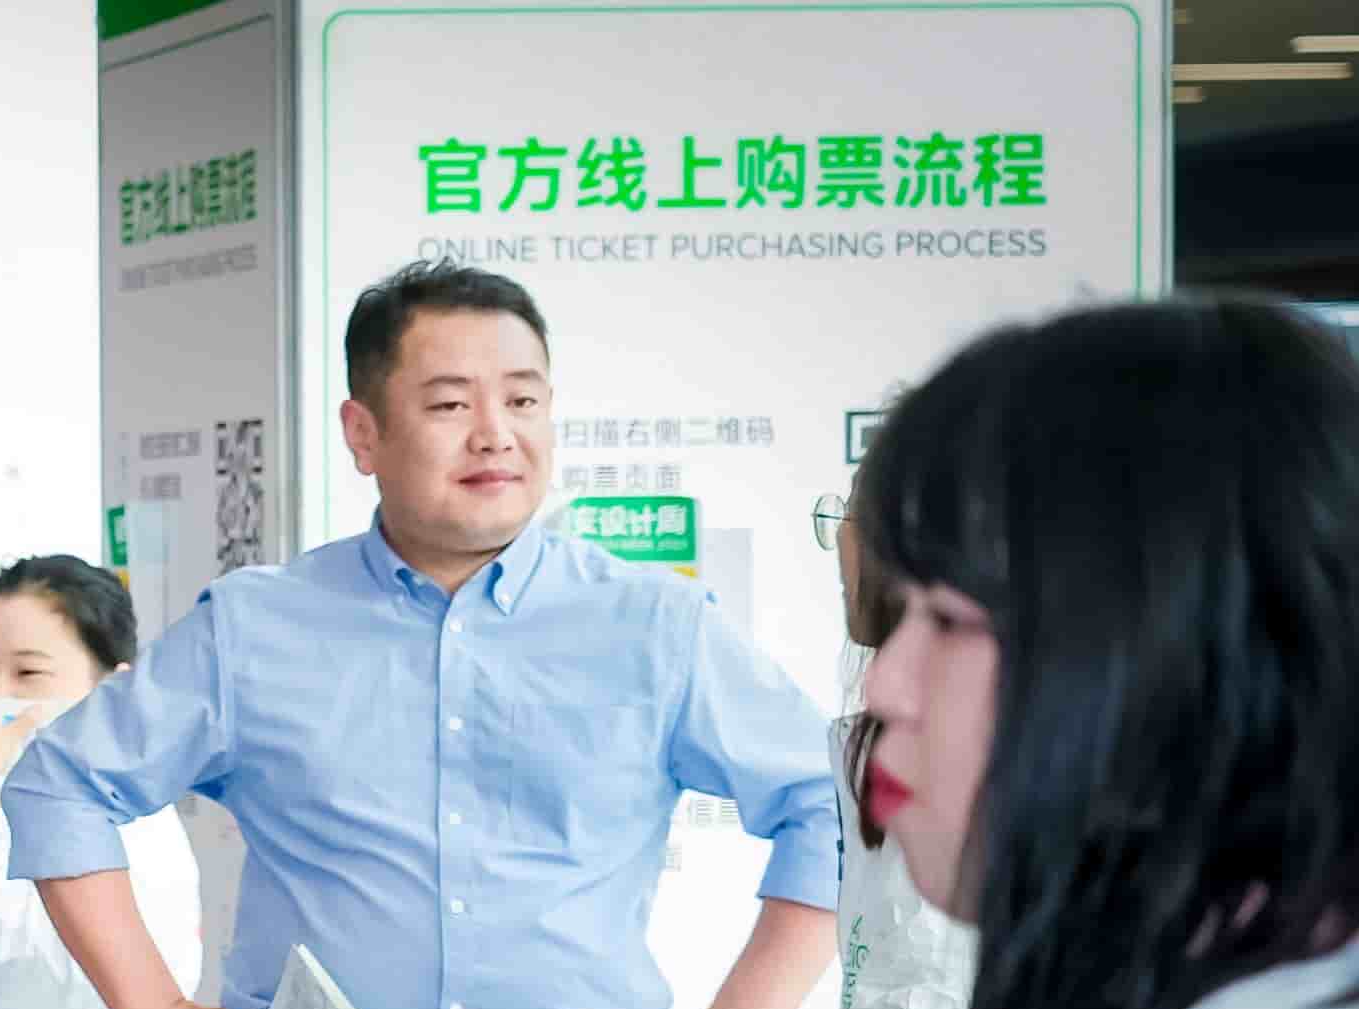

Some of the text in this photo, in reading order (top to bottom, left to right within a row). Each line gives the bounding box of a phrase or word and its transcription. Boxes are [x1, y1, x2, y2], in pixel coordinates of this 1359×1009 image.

[418, 134, 1048, 213] 官方线上购票流程
[418, 227, 1048, 263] ONLINE TICKET PURCHASING PROCESS
